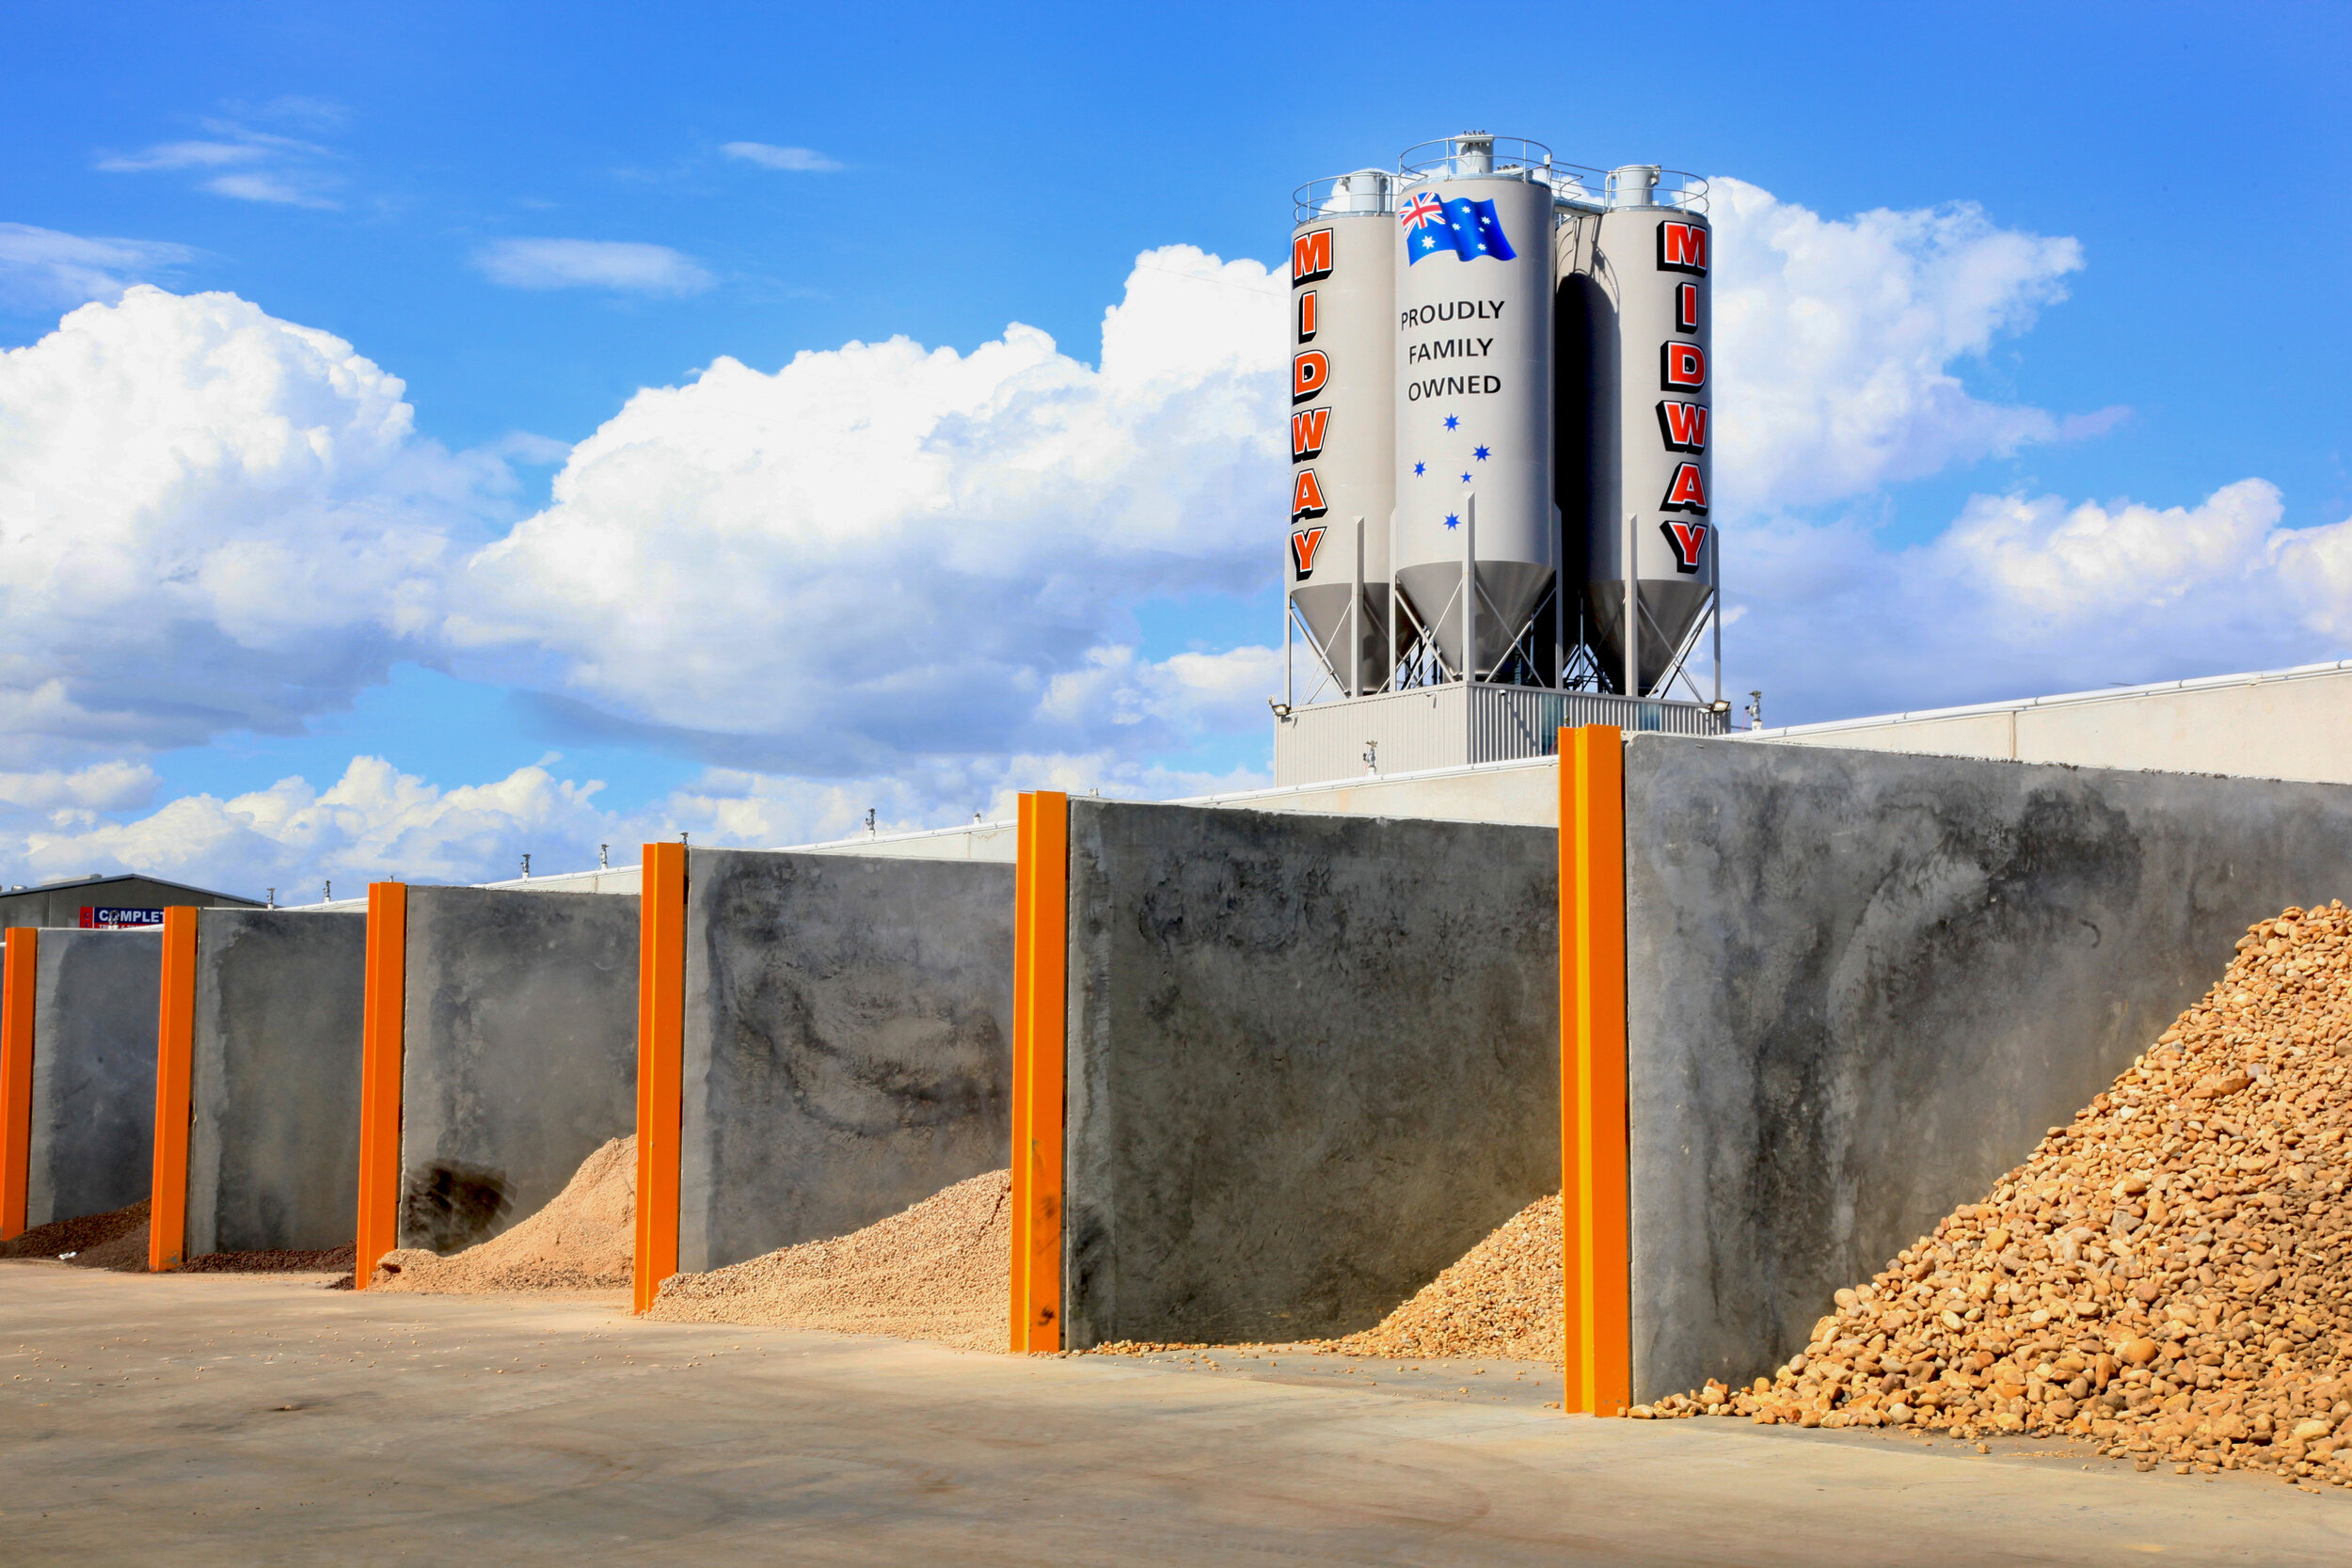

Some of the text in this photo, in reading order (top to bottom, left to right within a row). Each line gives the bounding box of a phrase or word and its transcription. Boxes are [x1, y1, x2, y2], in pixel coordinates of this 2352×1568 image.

[1401, 300, 1505, 331] PROUDLY
[1409, 338, 1494, 365] FAMILY
[1408, 375, 1502, 402] OWNED
[1656, 220, 1708, 574] MIDWAY
[1293, 228, 1334, 581] MIDWAY
